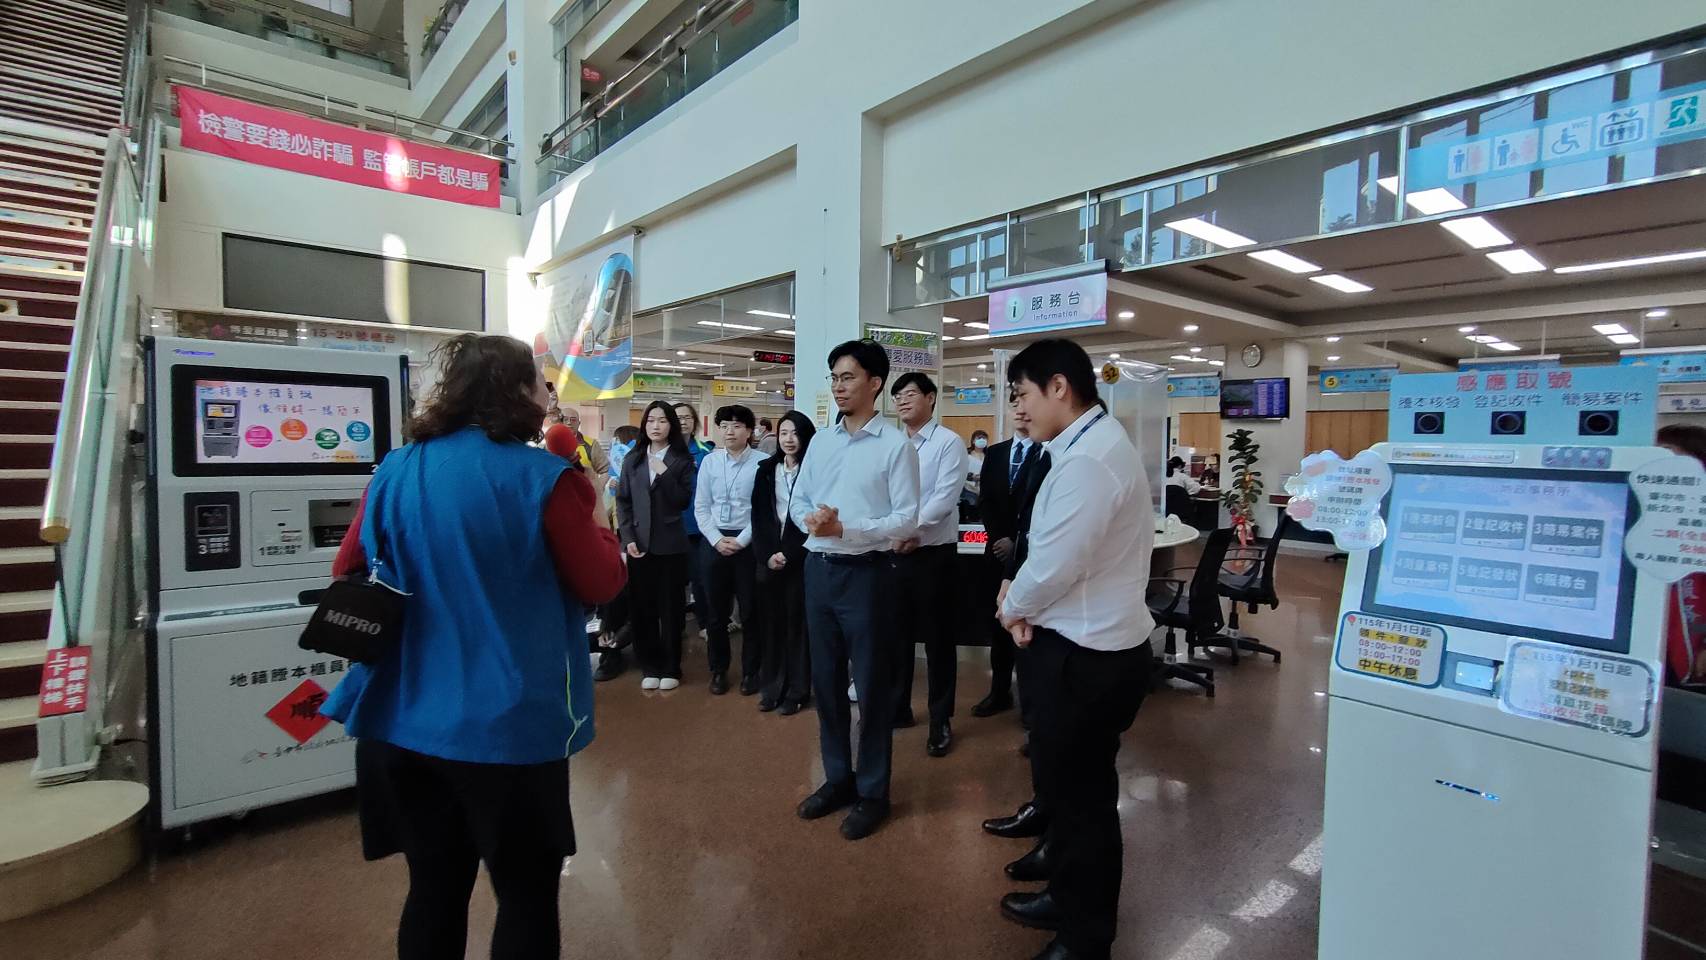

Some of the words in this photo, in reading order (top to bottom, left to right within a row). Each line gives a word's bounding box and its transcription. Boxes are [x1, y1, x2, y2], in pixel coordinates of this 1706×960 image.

[198, 109, 354, 166] 檢警要錢必詐騙
[1031, 290, 1081, 311] 服務台
[1327, 378, 1335, 386] 5
[1457, 371, 1573, 391] 感應取號
[1474, 394, 1544, 409] 登記收件
[1562, 391, 1643, 407] 簡易案件
[1465, 516, 1525, 533] 2登記收件
[1534, 523, 1601, 540] 3簡易案件
[199, 544, 208, 555] 3
[1535, 572, 1587, 590] 6服務台
[324, 609, 383, 636] MIPRO
[1359, 617, 1433, 637] 115年1月1日起
[1359, 638, 1422, 657] 08:00-12:00
[229, 658, 353, 688] 地籍謄本櫃員
[1359, 658, 1418, 681] 中午休息
